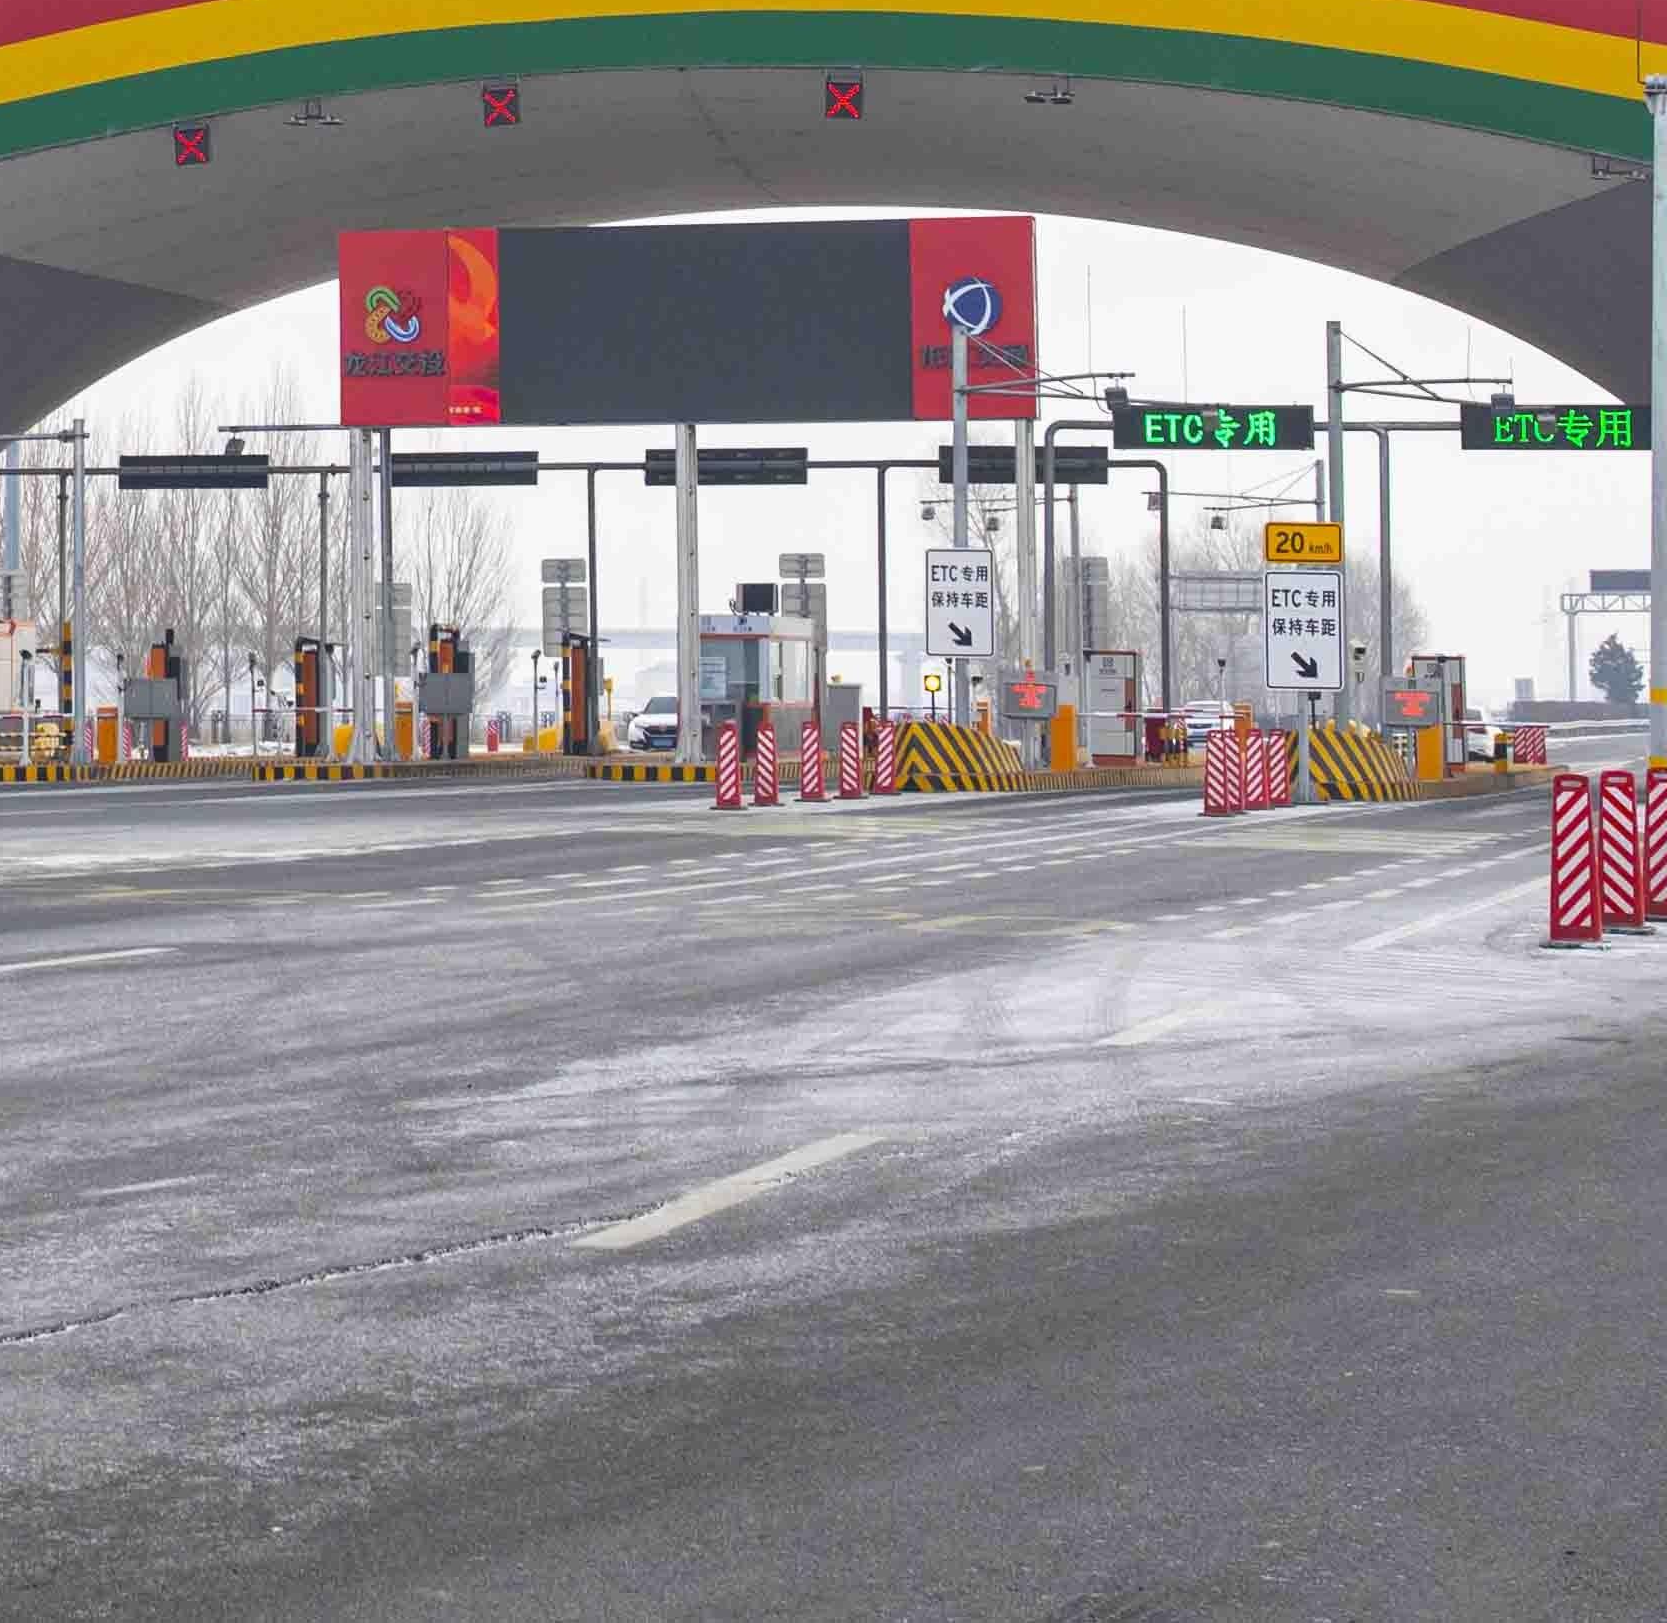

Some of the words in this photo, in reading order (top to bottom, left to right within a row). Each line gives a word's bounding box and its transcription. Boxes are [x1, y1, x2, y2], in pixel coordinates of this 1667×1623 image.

[1145, 413, 1204, 445] ETC
[1557, 409, 1633, 447] 专用
[1275, 531, 1305, 554] 20
[931, 565, 958, 582] ETC
[961, 565, 988, 582] 专用
[1271, 589, 1302, 608] ETC
[1305, 590, 1336, 608] 专用
[1272, 618, 1337, 637] 保持车距
